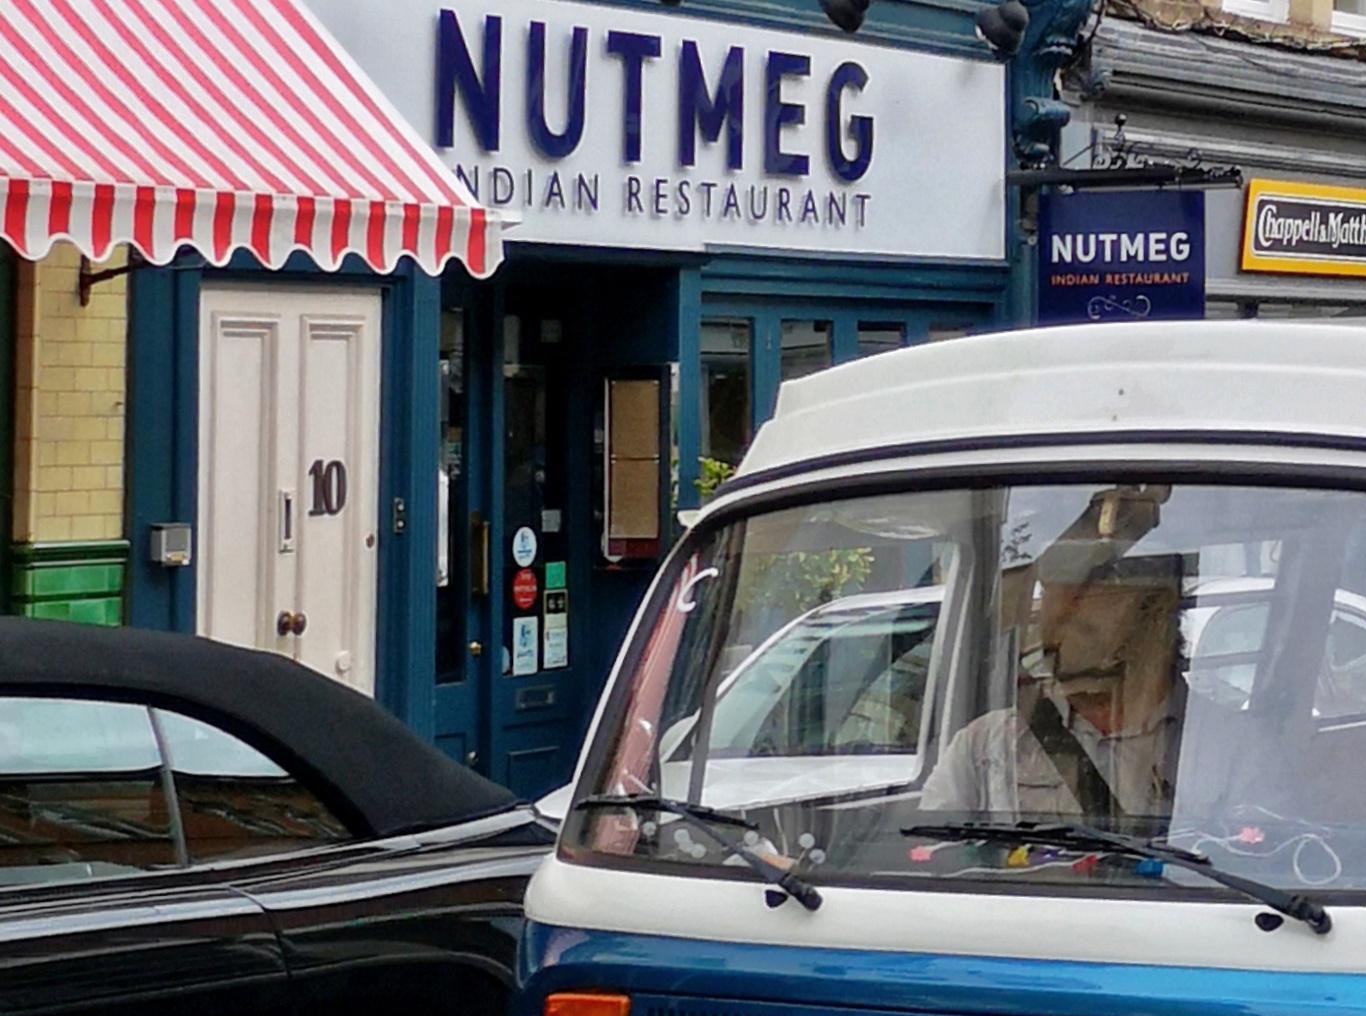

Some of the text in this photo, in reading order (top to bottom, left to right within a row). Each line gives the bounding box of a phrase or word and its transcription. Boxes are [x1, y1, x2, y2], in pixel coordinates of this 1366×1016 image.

[434, 9, 875, 183] NUTMEG
[456, 163, 871, 228] NDIAN RESTAURANT
[1051, 231, 1191, 263] NUTMEG
[1051, 271, 1190, 286] INDIAN RESTAURANT
[308, 459, 347, 516] 10
